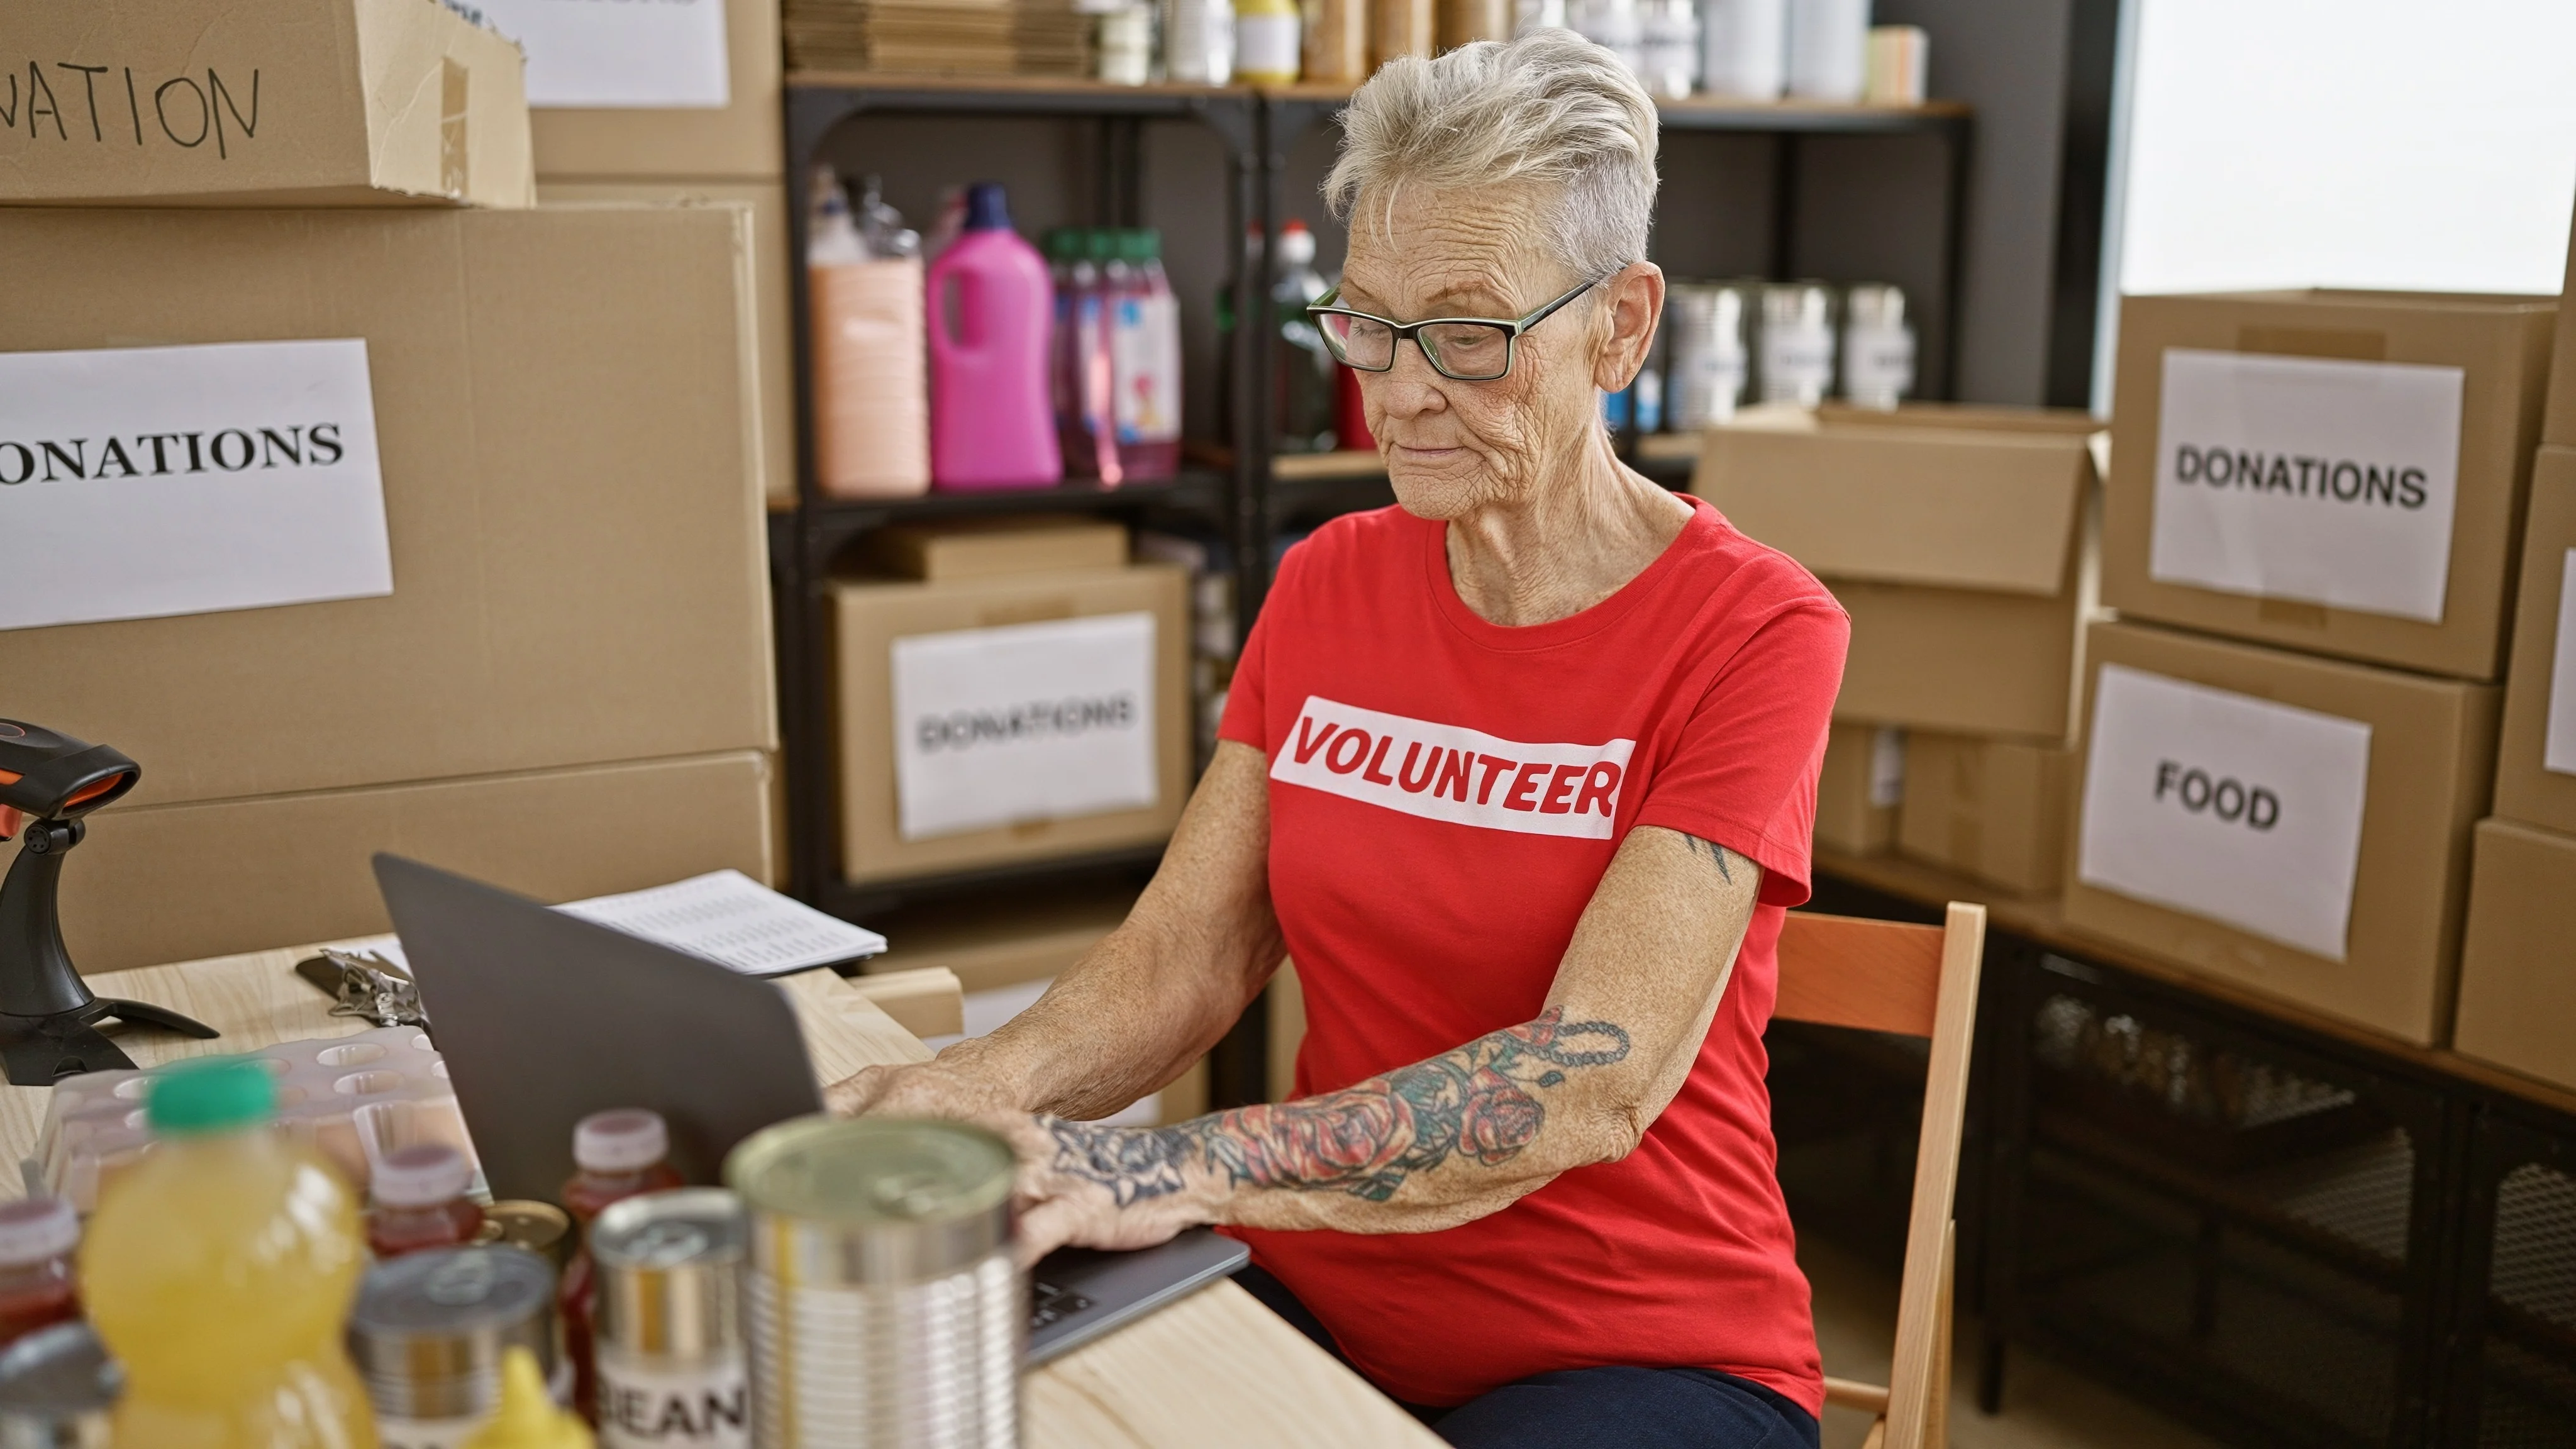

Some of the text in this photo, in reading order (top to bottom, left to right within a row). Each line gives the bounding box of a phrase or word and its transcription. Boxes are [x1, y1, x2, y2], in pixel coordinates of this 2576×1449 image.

[0, 423, 343, 485] ONATIONS
[2175, 444, 2428, 509] DONATIONS
[917, 692, 1138, 754] DONATIONS
[1294, 716, 1621, 818] VOLUNTEER
[2153, 758, 2281, 832] FOOD
